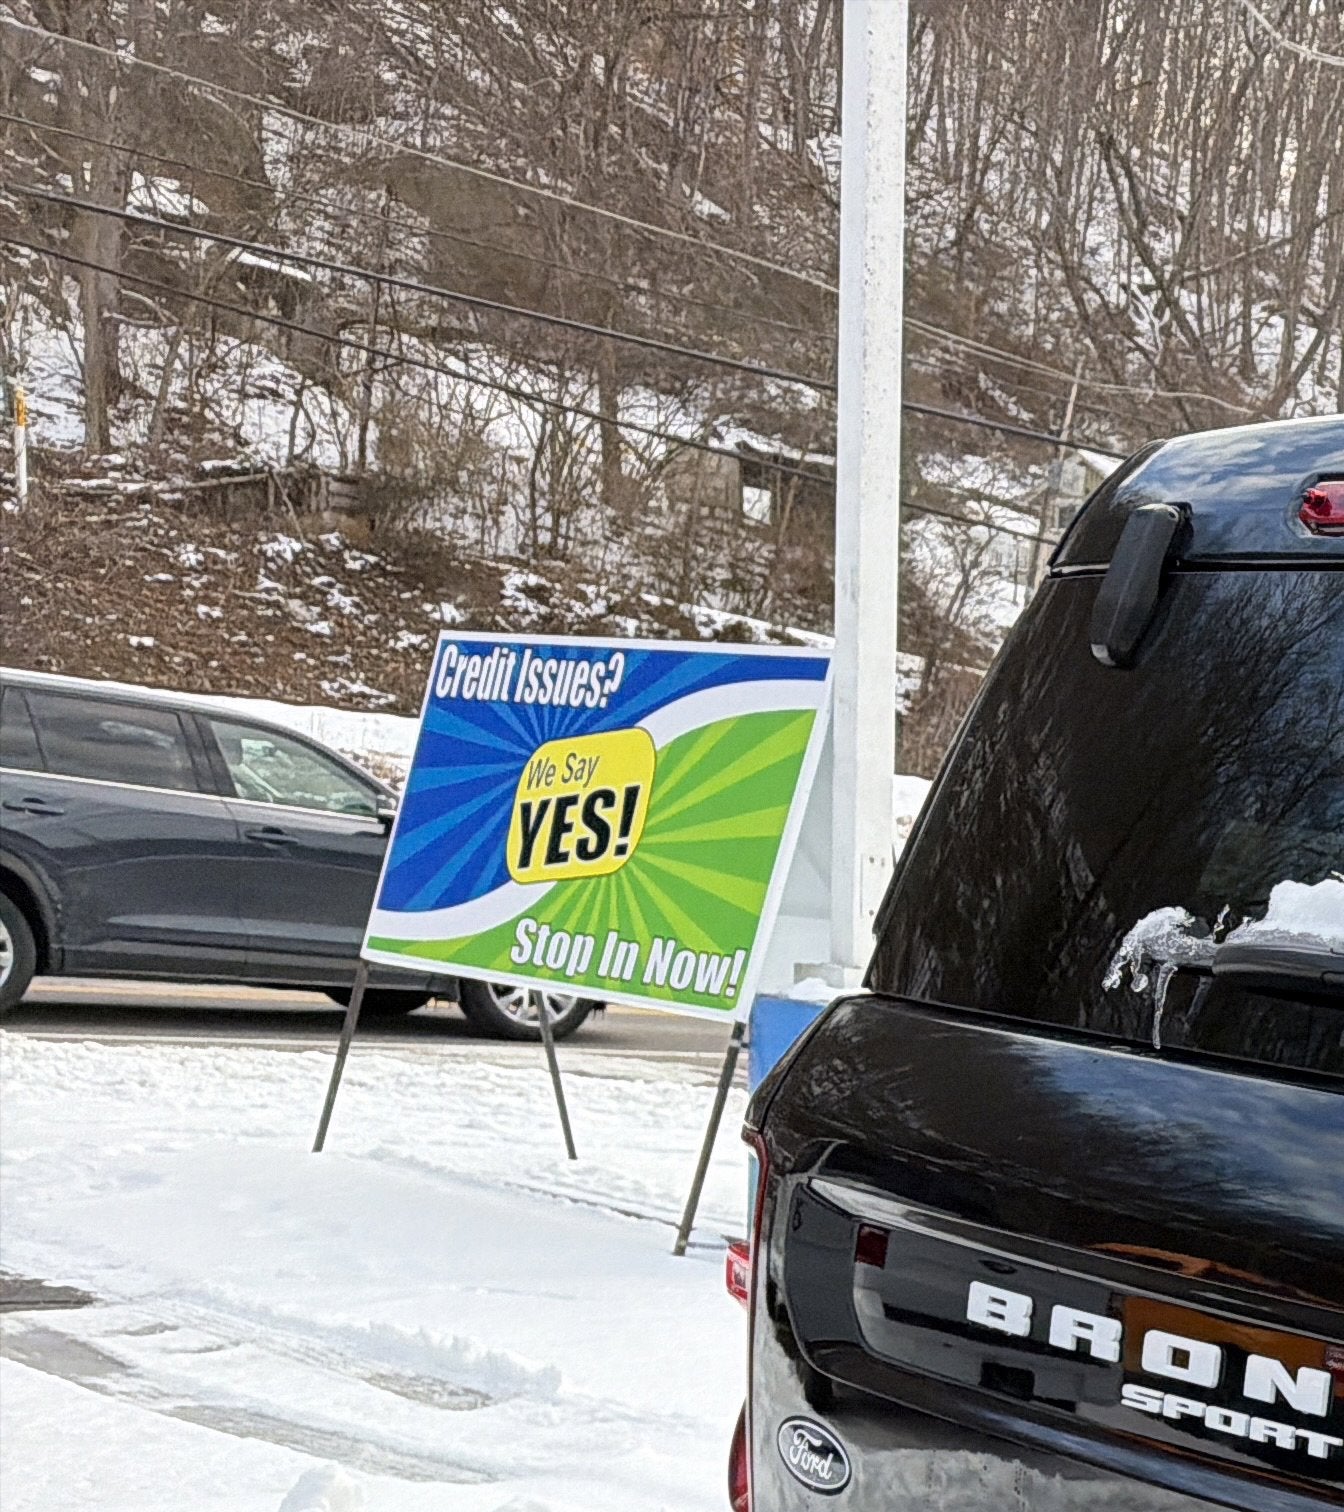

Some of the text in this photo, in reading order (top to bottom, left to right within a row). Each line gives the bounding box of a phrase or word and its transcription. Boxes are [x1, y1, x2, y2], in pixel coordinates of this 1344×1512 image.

[435, 645, 625, 708] Credit Issues?
[527, 752, 600, 790] We Say
[517, 784, 641, 869] YES!
[510, 918, 746, 997] Stop In Now!
[789, 1428, 835, 1480] Ford
[1121, 1384, 1344, 1459] SPORT
